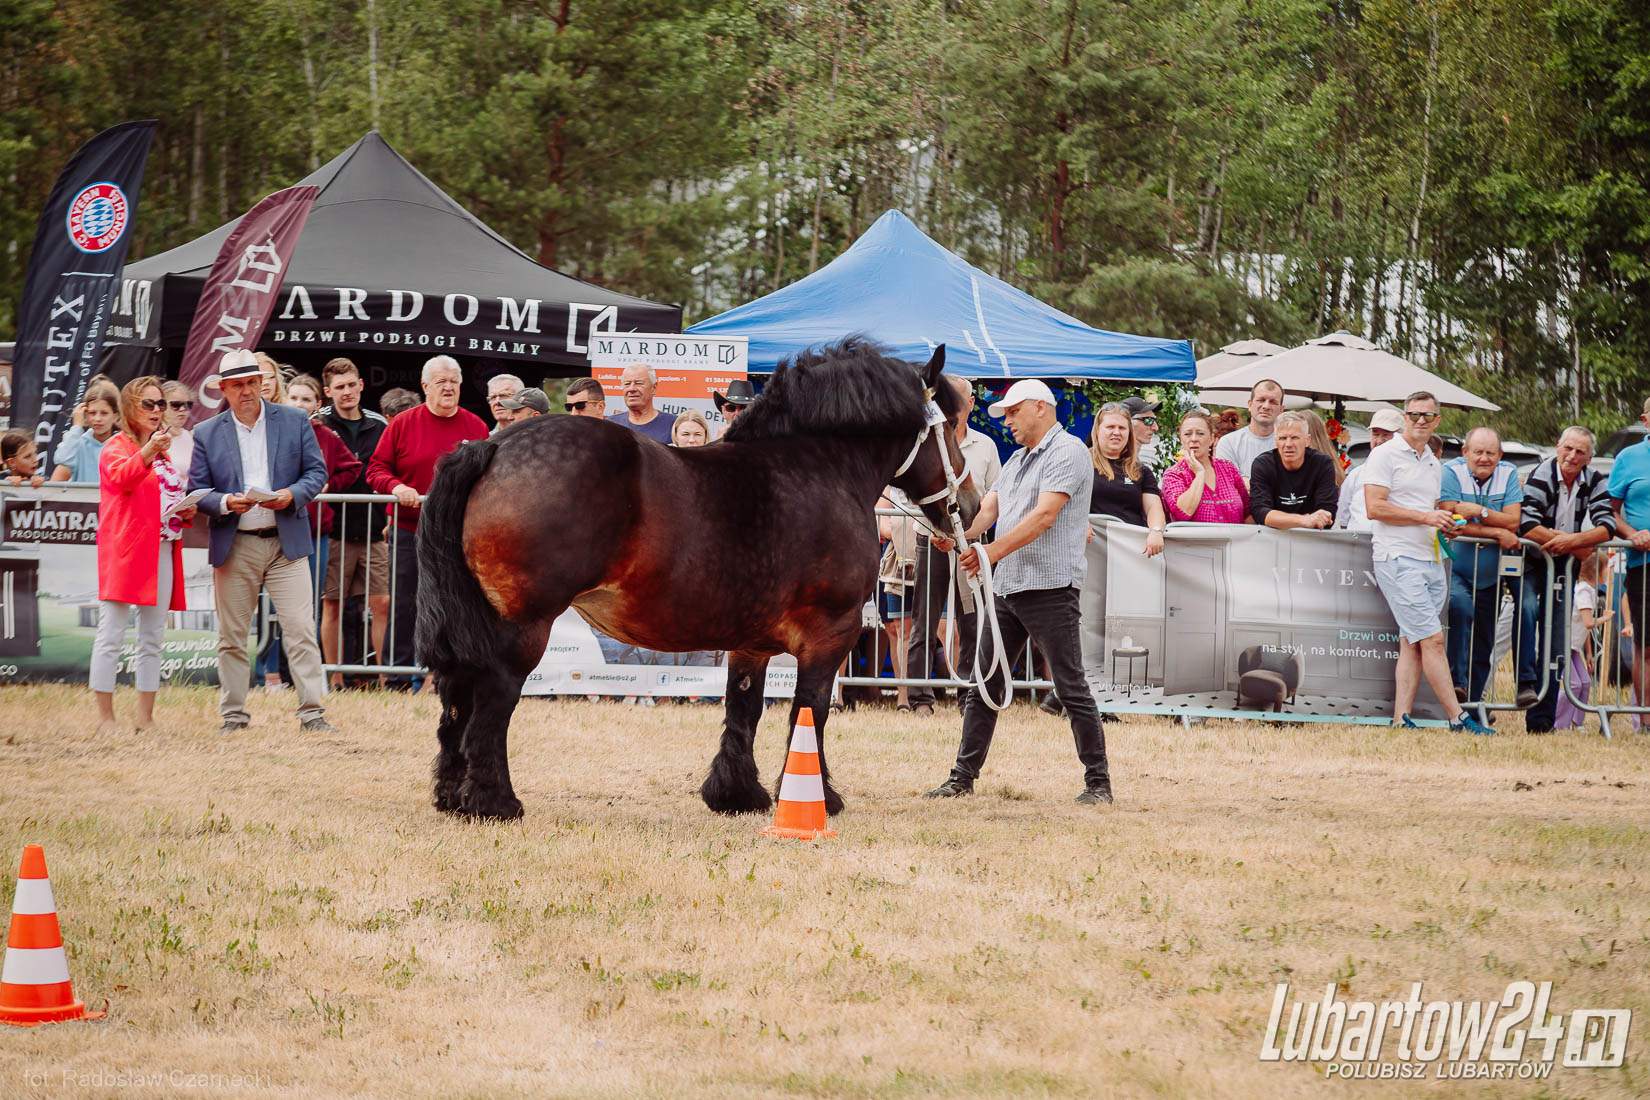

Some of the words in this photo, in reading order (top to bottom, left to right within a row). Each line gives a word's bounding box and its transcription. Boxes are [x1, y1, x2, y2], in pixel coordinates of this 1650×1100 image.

[274, 330, 346, 343] DRZWI
[358, 331, 457, 349] PODŁOGI
[468, 338, 541, 356] BRAMY
[598, 340, 709, 357] MARDOM
[10, 530, 78, 542] PRODUCENT
[1339, 629, 1375, 642] Drzwi
[1261, 643, 1278, 653] na
[1280, 643, 1307, 656] styl,
[1310, 646, 1326, 656] na
[1329, 645, 1381, 660] komfort,
[1384, 650, 1401, 660] na
